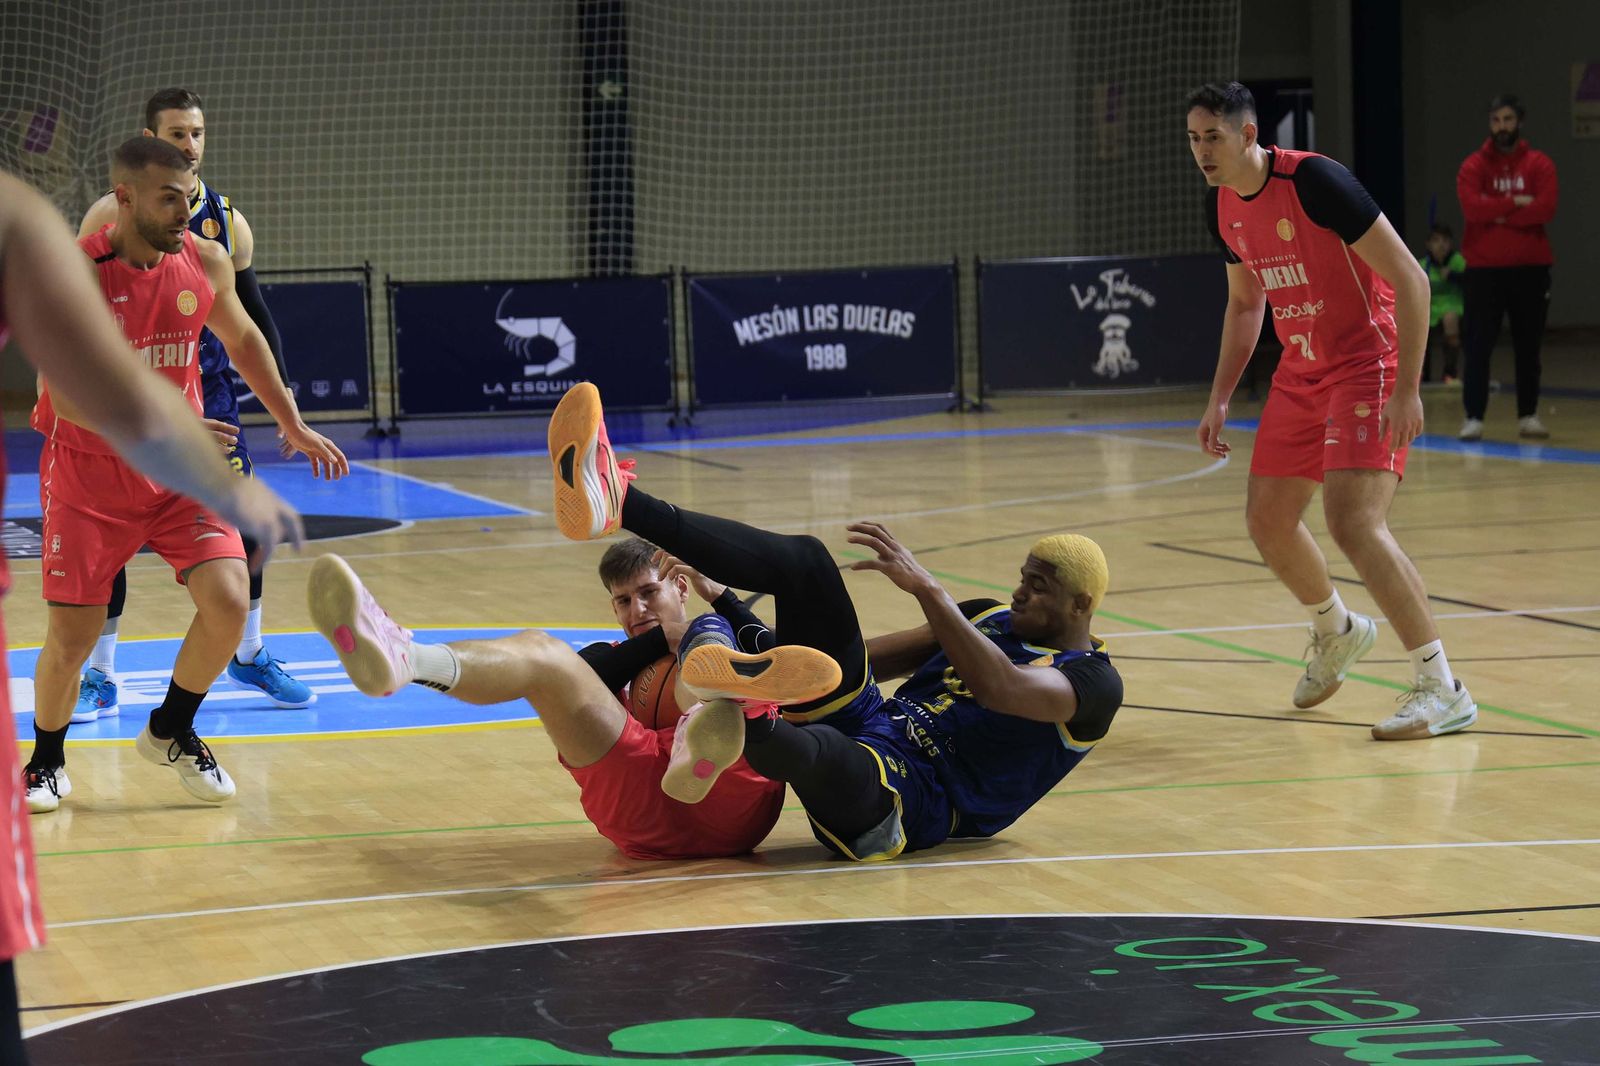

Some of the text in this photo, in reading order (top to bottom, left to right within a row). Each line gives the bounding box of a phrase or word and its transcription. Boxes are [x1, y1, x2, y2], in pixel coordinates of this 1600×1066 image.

[732, 304, 915, 346] MESÓN LAS DUELAS
[804, 343, 847, 371] 1988
[483, 382, 505, 394] LA
